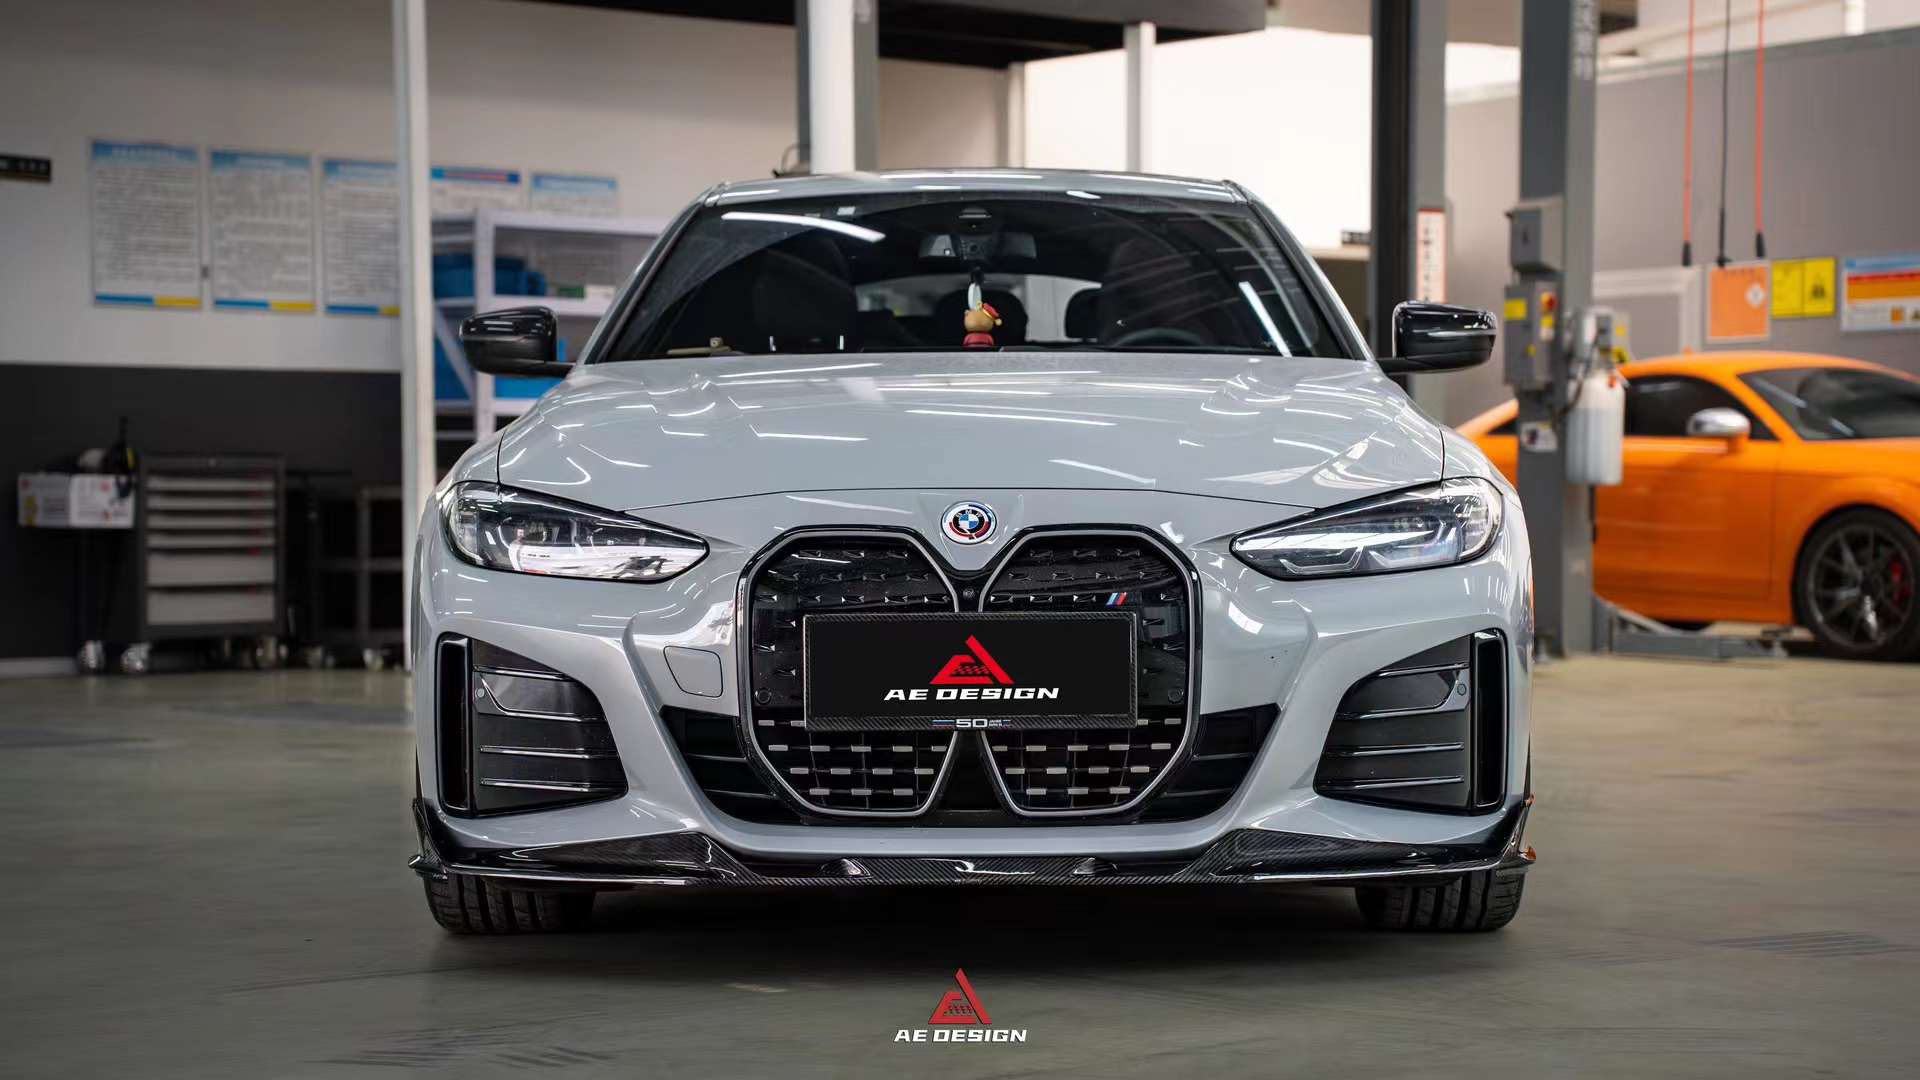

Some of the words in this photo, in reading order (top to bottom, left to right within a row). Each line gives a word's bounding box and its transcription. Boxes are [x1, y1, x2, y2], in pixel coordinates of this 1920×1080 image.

[884, 689, 929, 700] AE
[935, 687, 1060, 700] DESIGN
[956, 718, 988, 728] 50
